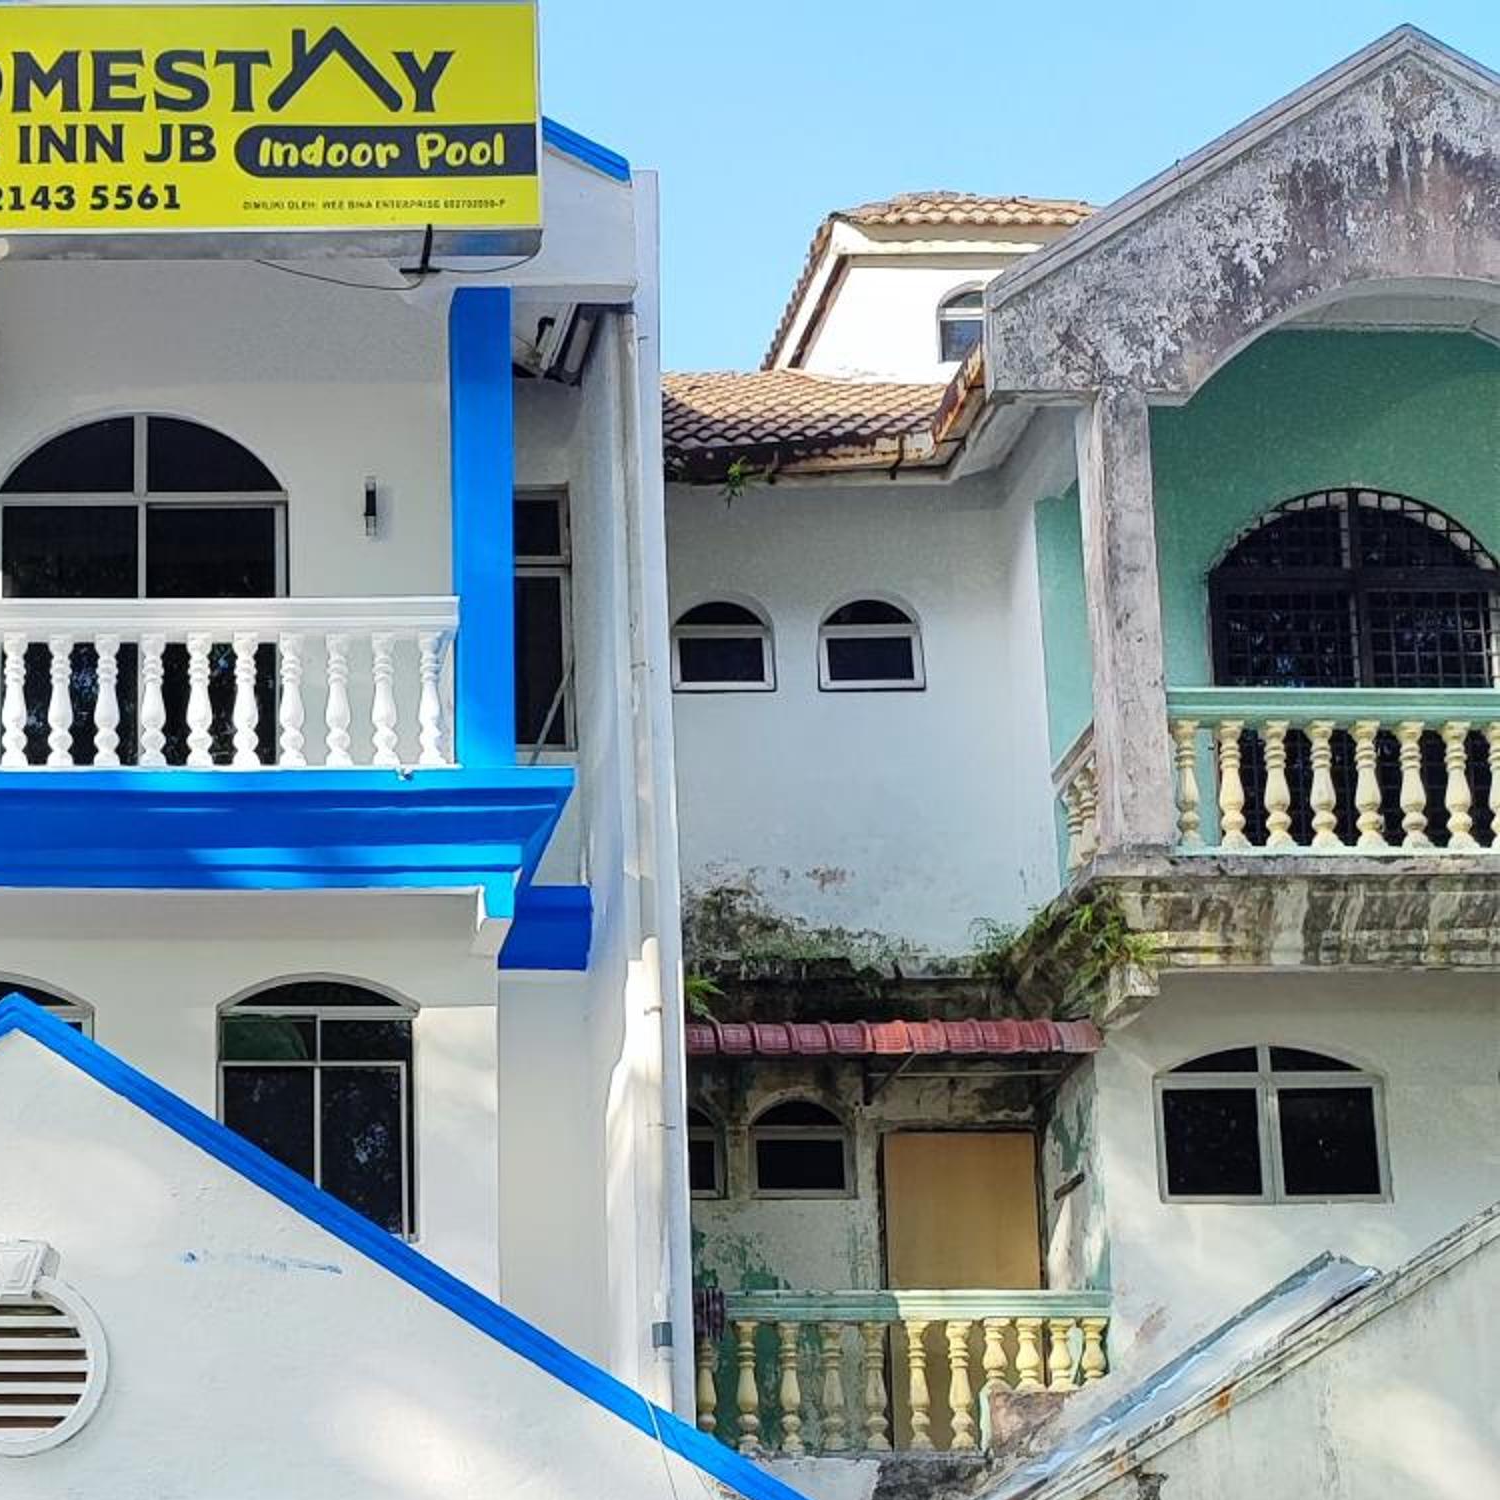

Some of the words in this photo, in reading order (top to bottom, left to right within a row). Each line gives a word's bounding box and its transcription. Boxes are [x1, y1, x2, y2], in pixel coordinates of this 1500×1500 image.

[18, 124, 124, 165] INN
[143, 124, 217, 164] JB
[259, 134, 401, 169] Indoor
[416, 133, 505, 170] Pool
[89, 184, 181, 211] 5561
